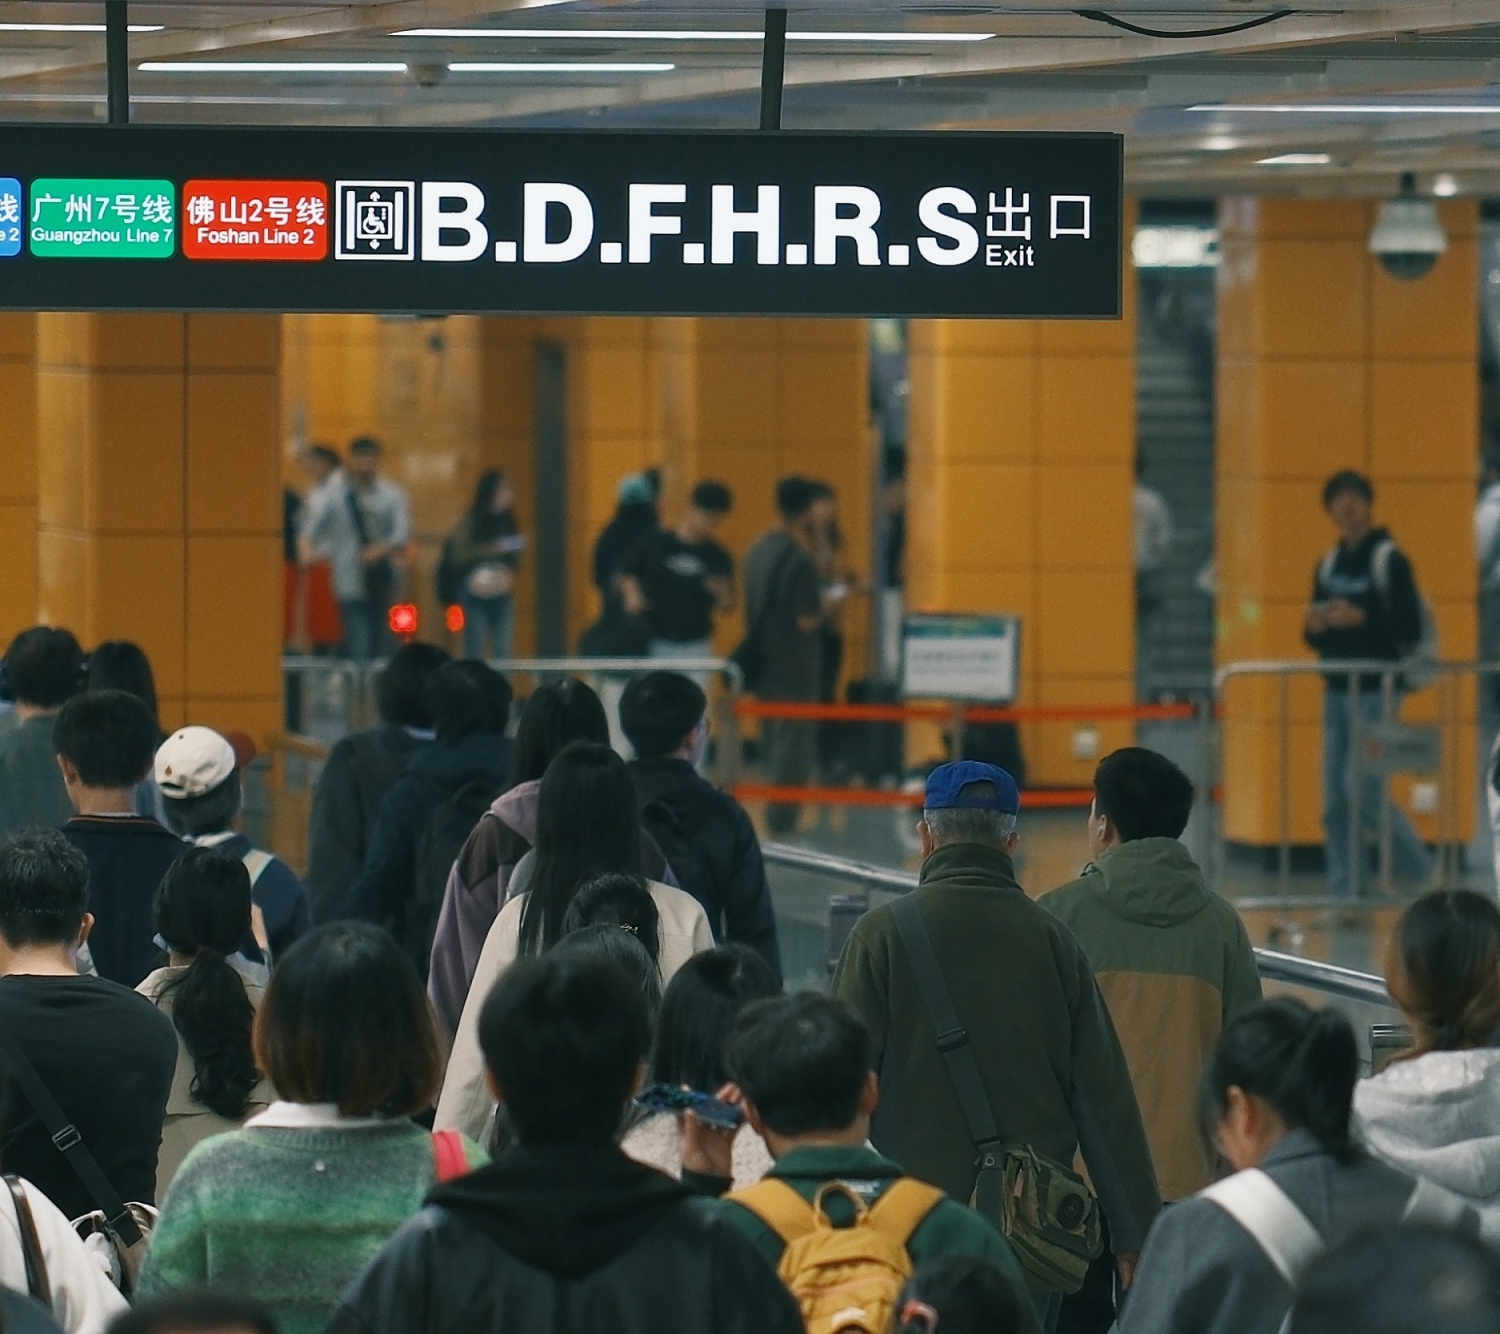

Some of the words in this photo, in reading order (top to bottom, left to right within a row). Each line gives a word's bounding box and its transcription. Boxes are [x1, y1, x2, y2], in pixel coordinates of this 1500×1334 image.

[32, 193, 173, 225] 广州7号线
[187, 195, 326, 226] 佛山2号线
[986, 187, 1092, 239] 出口
[9, 228, 19, 242] 2
[31, 227, 121, 246] Guangzhou
[127, 228, 160, 243] Line
[163, 229, 173, 243] 7
[197, 227, 260, 245] Foshan
[264, 228, 300, 244] Line
[303, 229, 314, 244] 2
[421, 182, 980, 266] B.D.F.H.R.S
[986, 244, 1035, 267] Exit
